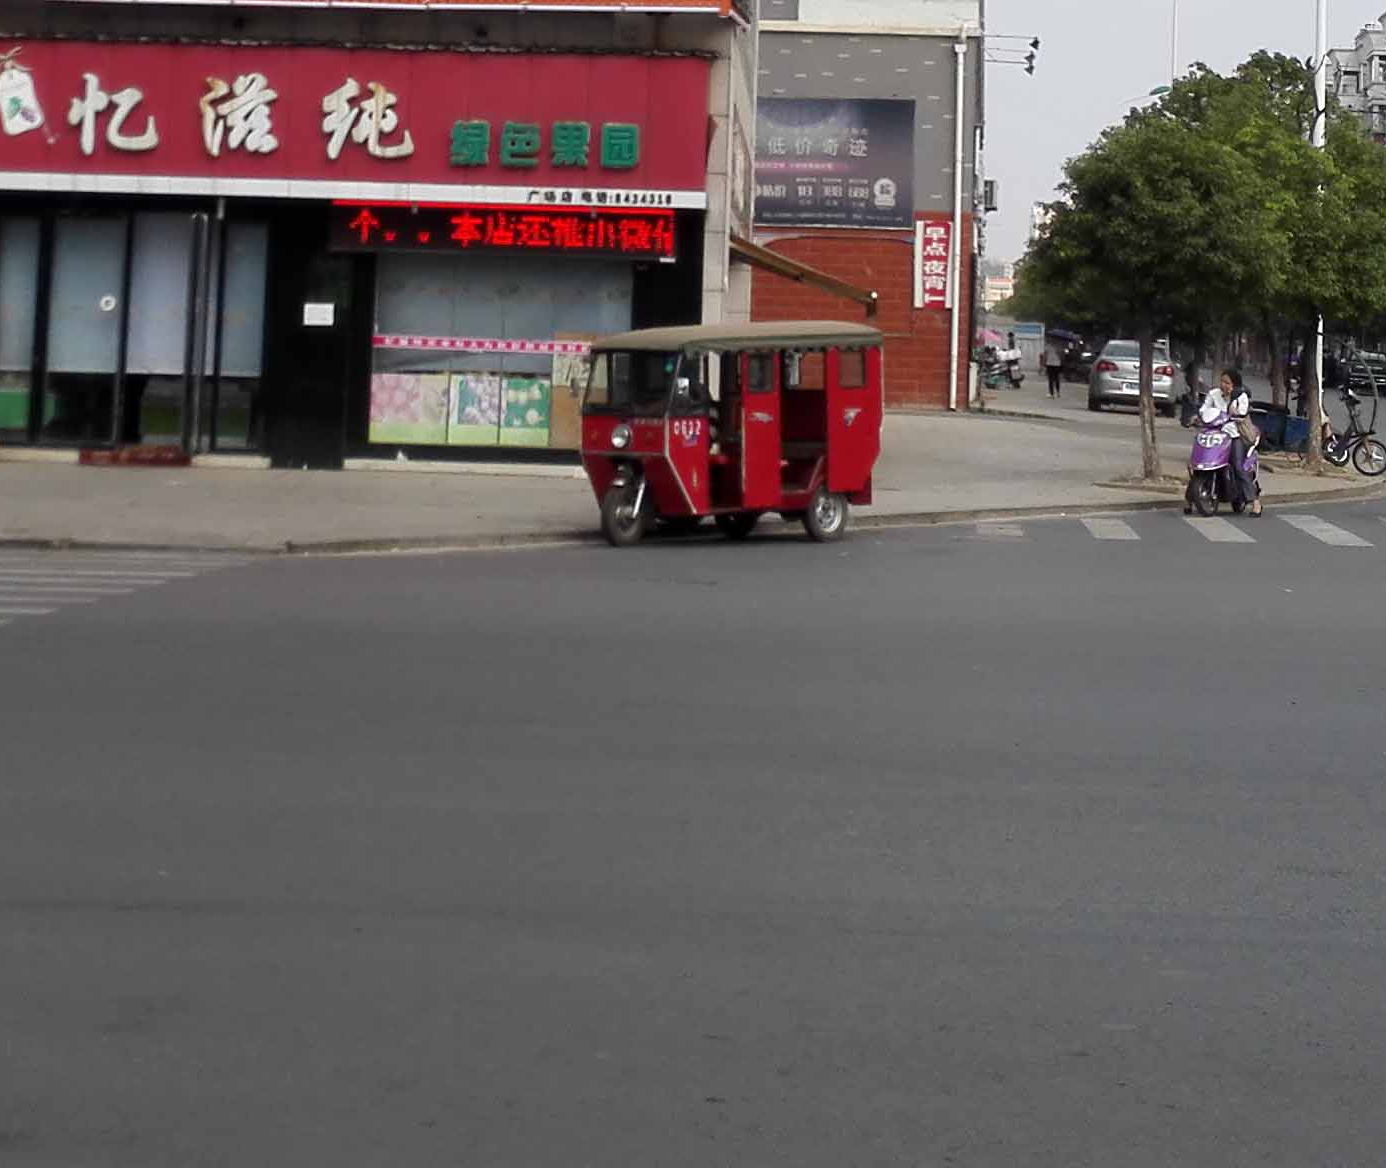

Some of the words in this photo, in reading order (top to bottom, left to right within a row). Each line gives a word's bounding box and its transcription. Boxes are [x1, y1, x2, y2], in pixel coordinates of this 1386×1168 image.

[67, 72, 415, 161] 忆滋纯
[449, 119, 641, 169] 绿色果园
